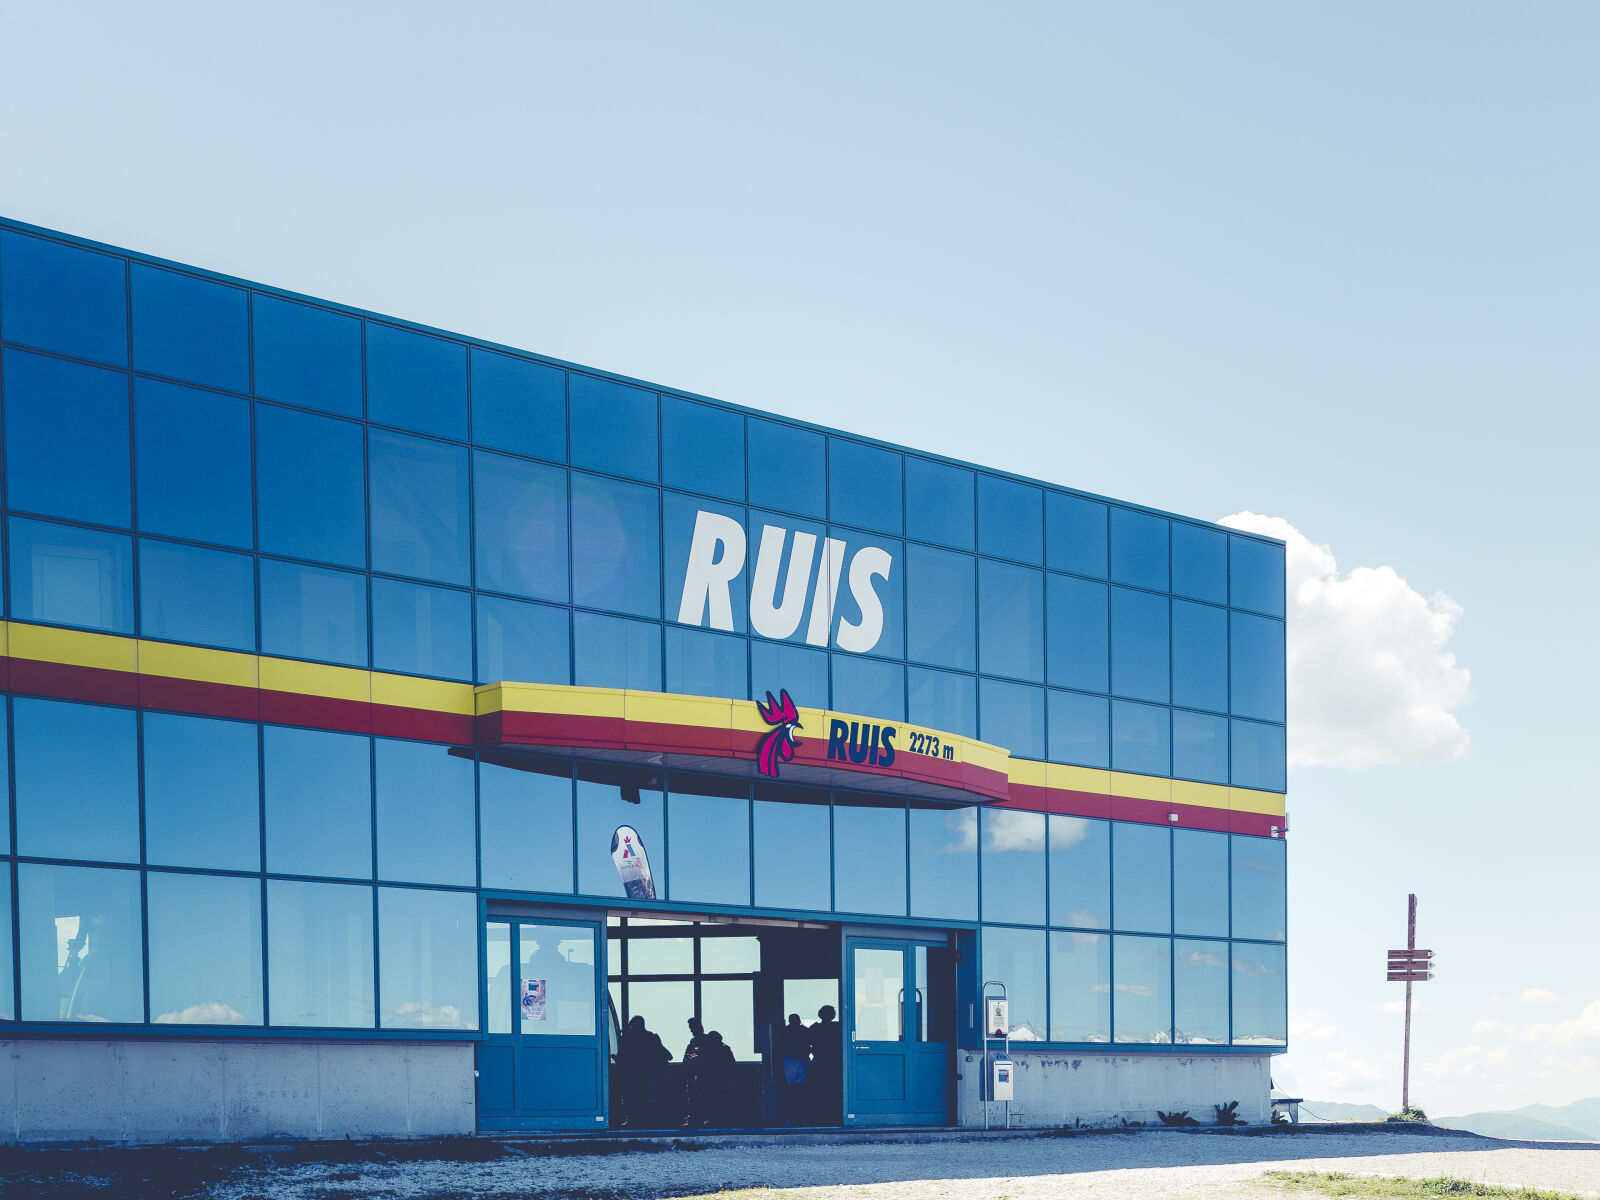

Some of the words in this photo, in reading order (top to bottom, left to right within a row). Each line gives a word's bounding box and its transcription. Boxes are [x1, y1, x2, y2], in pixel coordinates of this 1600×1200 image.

[677, 510, 893, 653] RUIS
[827, 718, 897, 768] RUIS
[909, 731, 940, 758] 2273
[942, 744, 954, 760] m
